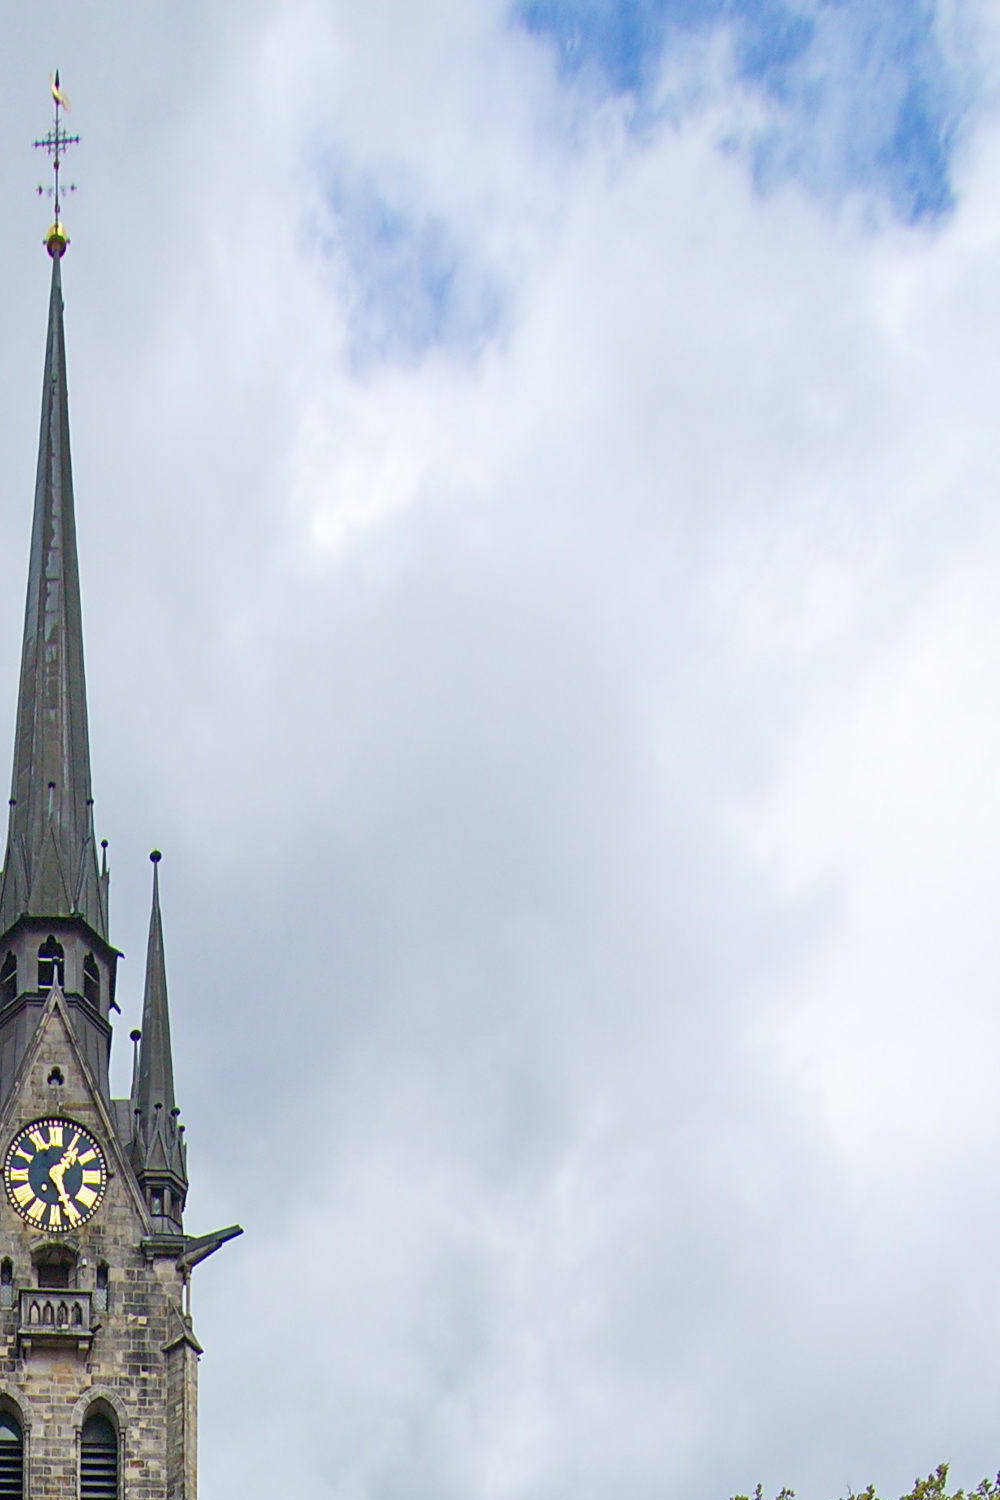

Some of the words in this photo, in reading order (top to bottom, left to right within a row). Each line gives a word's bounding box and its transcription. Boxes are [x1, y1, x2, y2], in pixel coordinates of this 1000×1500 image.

[28, 1130, 50, 1153] XI
[48, 1126, 64, 1148] XII
[15, 1146, 35, 1164] X
[77, 1148, 97, 1166] II
[10, 1167, 29, 1181] IX
[82, 1169, 101, 1185] III
[48, 1204, 62, 1226] VI
